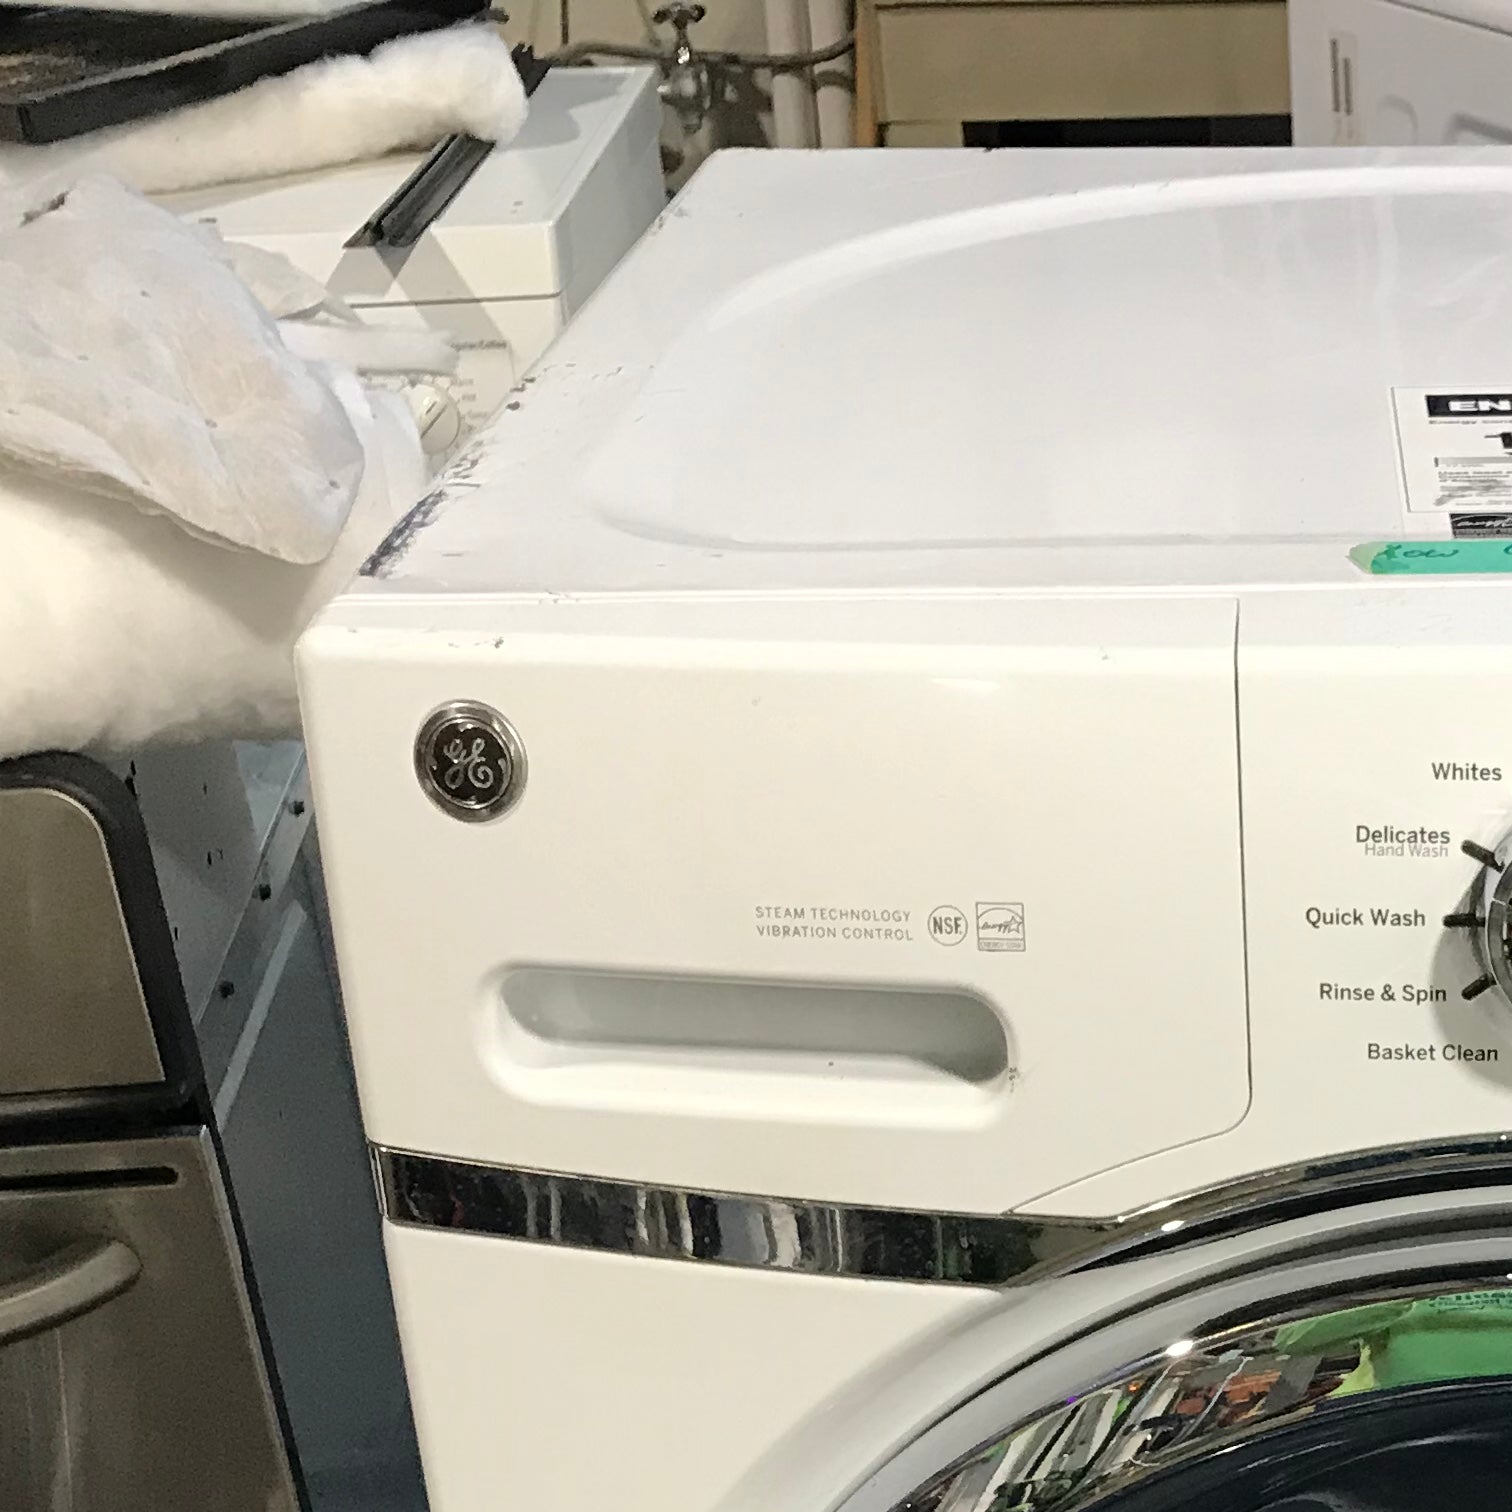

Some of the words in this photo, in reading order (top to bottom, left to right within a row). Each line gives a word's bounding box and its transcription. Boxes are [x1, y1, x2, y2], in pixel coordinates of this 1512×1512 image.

[1431, 761, 1503, 782] Whites
[1355, 825, 1451, 845] Delicates
[1364, 842, 1405, 857] Hand
[1408, 844, 1449, 858] Wash
[755, 906, 806, 921] STEAM
[811, 907, 912, 923] TECHNOLOGY
[1305, 907, 1364, 928] Quick
[1370, 908, 1426, 927] Wash
[756, 924, 837, 939] VIBRATION
[841, 927, 914, 942] CONTROL
[933, 916, 962, 935] NSF
[1318, 982, 1375, 1001] Rinse
[1380, 984, 1396, 1002] &
[1402, 984, 1448, 1006] Spin
[1367, 1042, 1437, 1061] Basket
[1442, 1044, 1499, 1062] Clean
